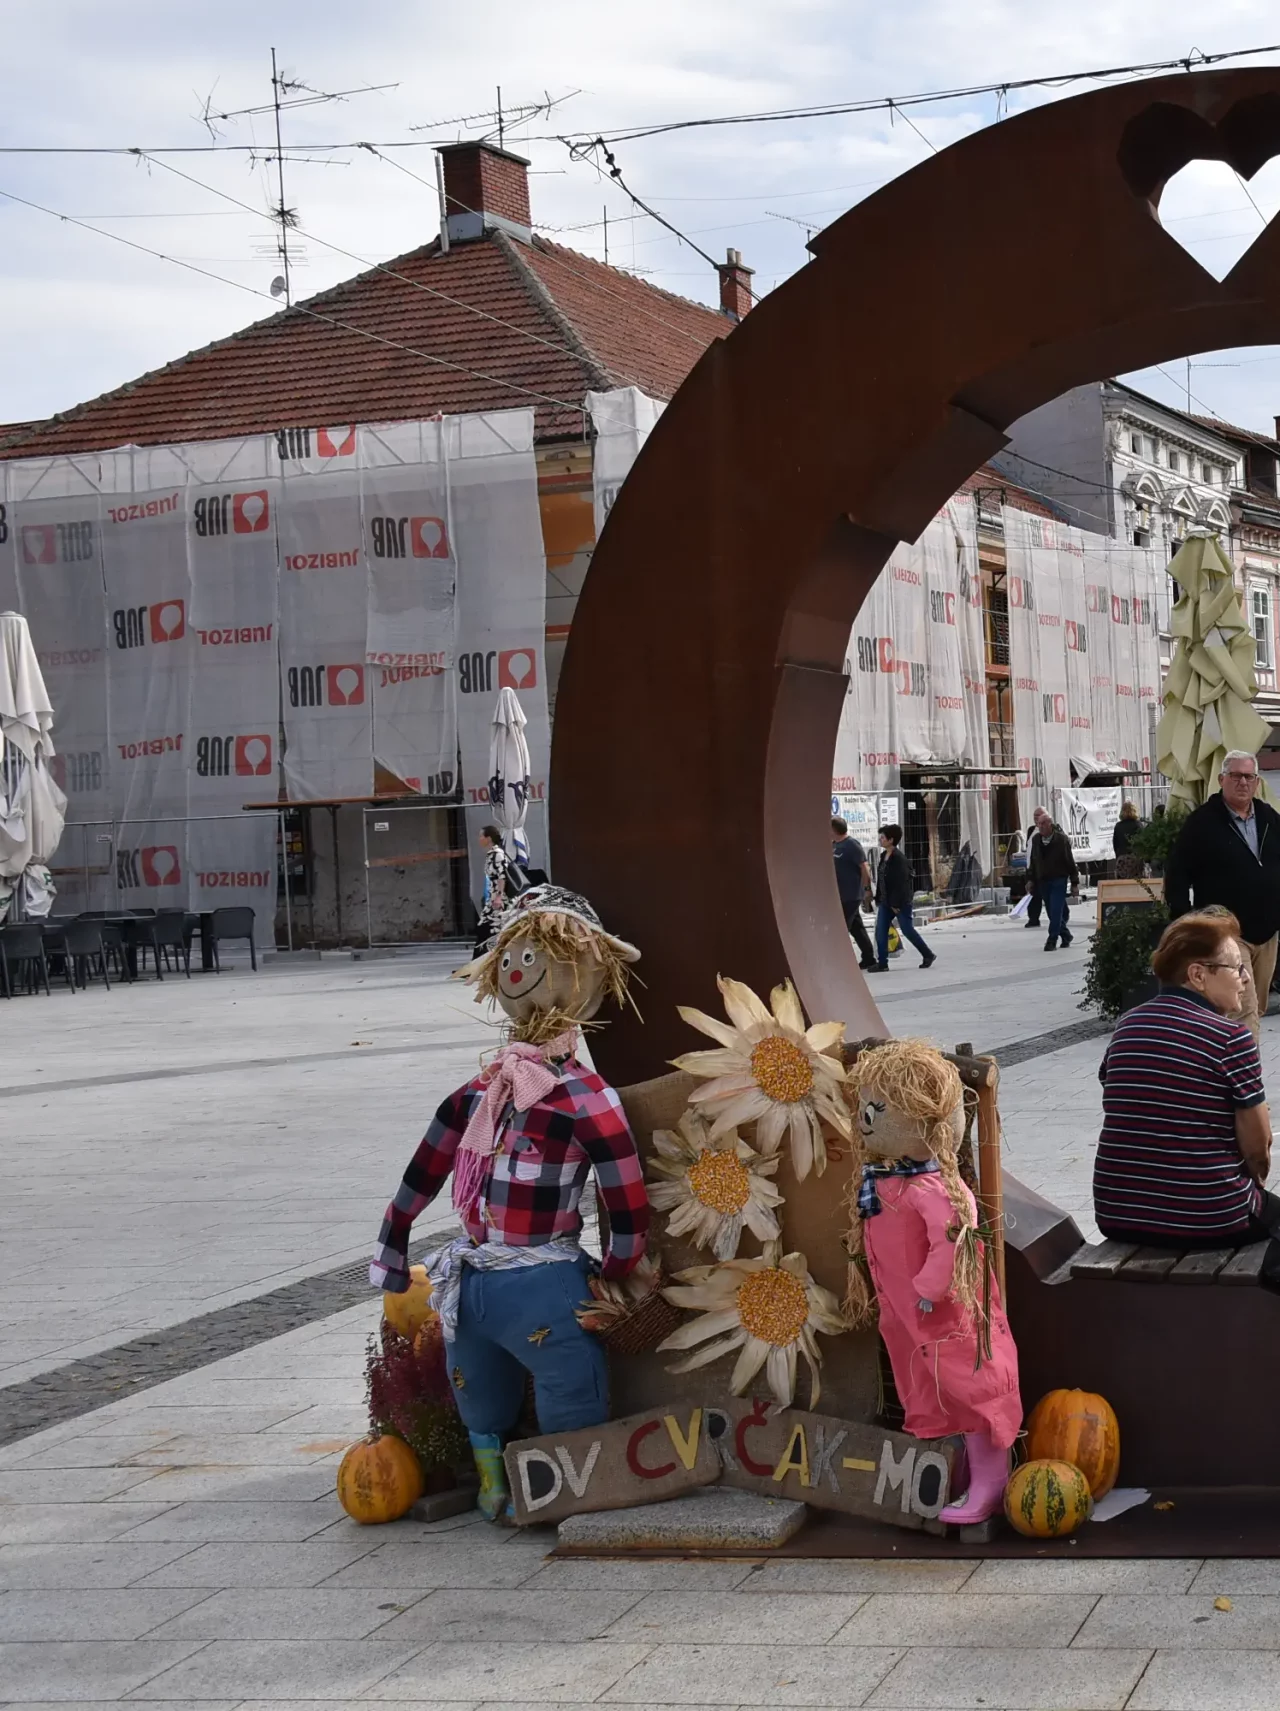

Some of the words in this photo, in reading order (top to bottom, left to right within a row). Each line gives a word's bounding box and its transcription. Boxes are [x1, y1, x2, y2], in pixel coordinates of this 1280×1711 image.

[107, 492, 180, 524] JUBIZOL
[194, 493, 232, 537] JUB
[371, 516, 408, 558] JUB
[284, 548, 359, 571] JUBIZOL
[930, 590, 945, 623] JUB
[113, 606, 147, 650] JUB
[197, 623, 273, 646] JUBIZOL
[458, 650, 497, 693] JUB
[857, 636, 877, 673] JUB
[288, 665, 325, 707] JUB
[117, 733, 184, 760] JUBIZOL
[197, 736, 234, 776] JUB
[1071, 837, 1091, 850] ALER
[197, 870, 270, 888] JUBIZOL
[517, 1440, 603, 1513] DV
